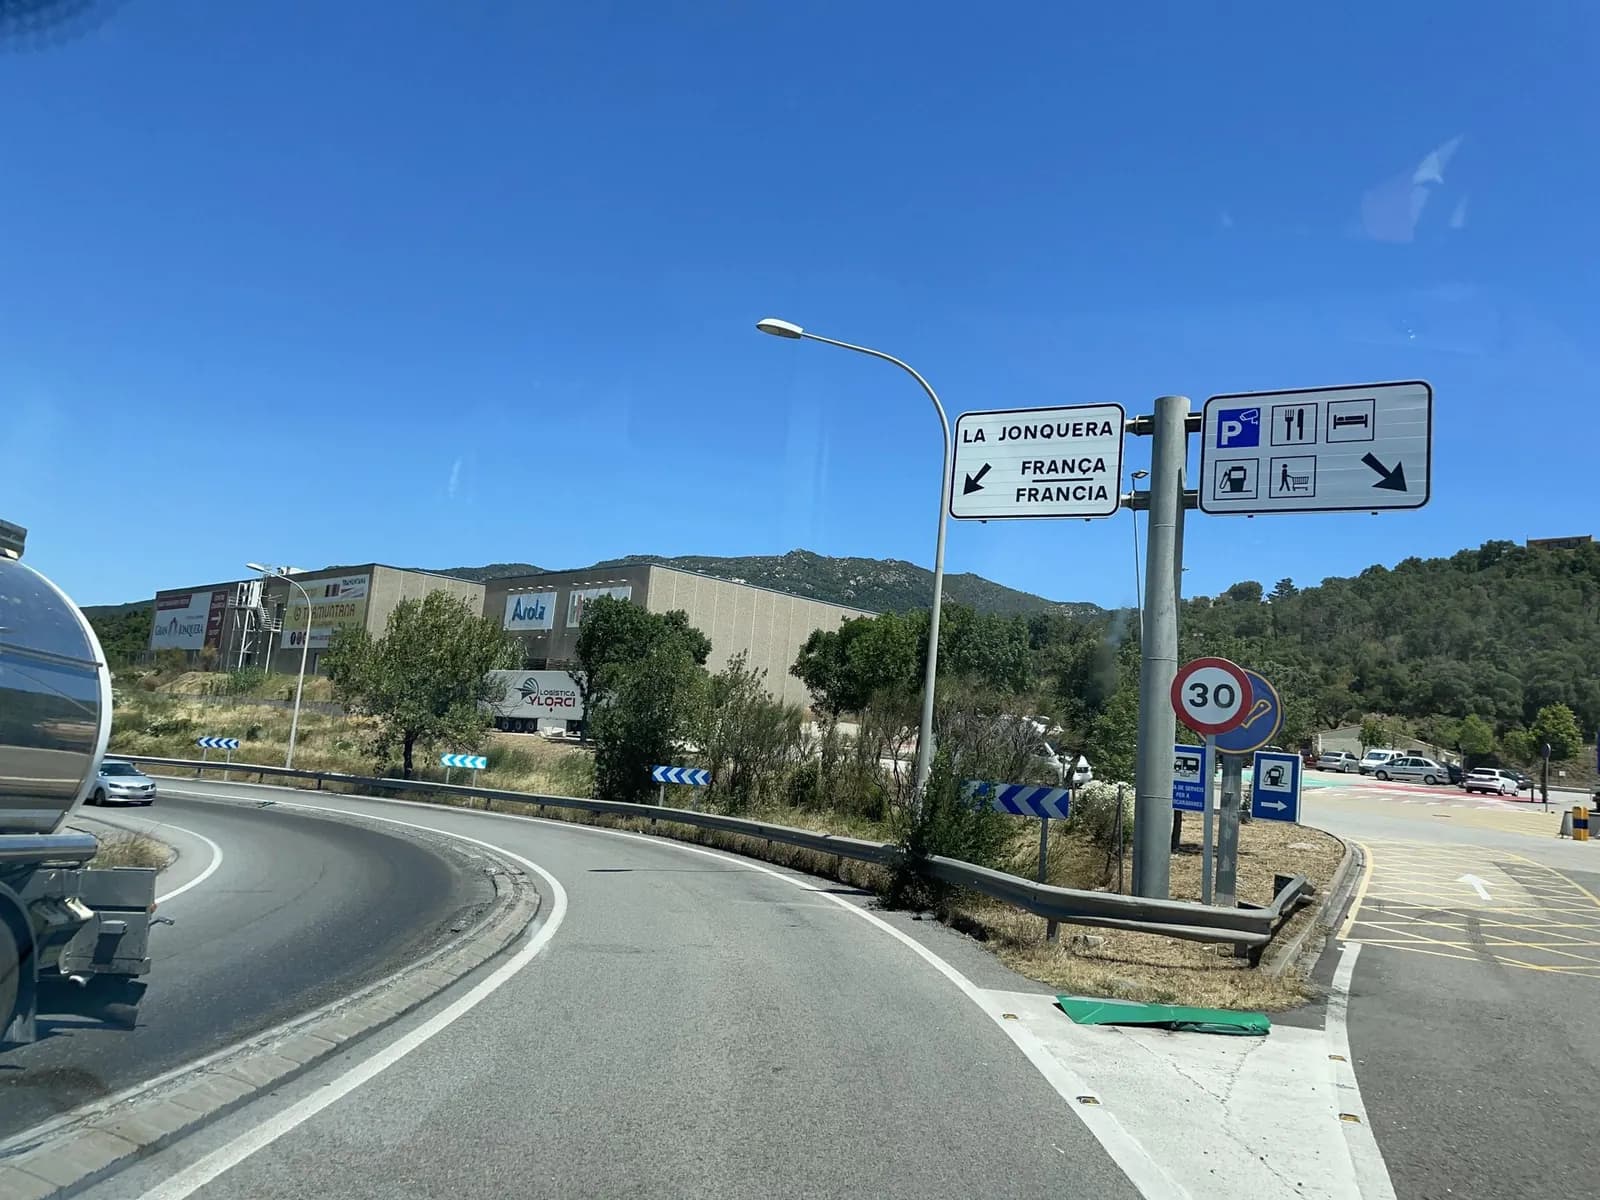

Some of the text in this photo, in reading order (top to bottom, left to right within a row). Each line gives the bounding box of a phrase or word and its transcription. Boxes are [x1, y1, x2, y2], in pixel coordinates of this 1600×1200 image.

[963, 421, 1114, 443] LA JONQUERA
[1221, 420, 1243, 445] P
[1021, 457, 1106, 475] FRANÇA
[1015, 485, 1109, 503] FRANCIA
[511, 597, 546, 621] Arola
[528, 696, 576, 708] YLORCI
[1188, 682, 1236, 709] 30
